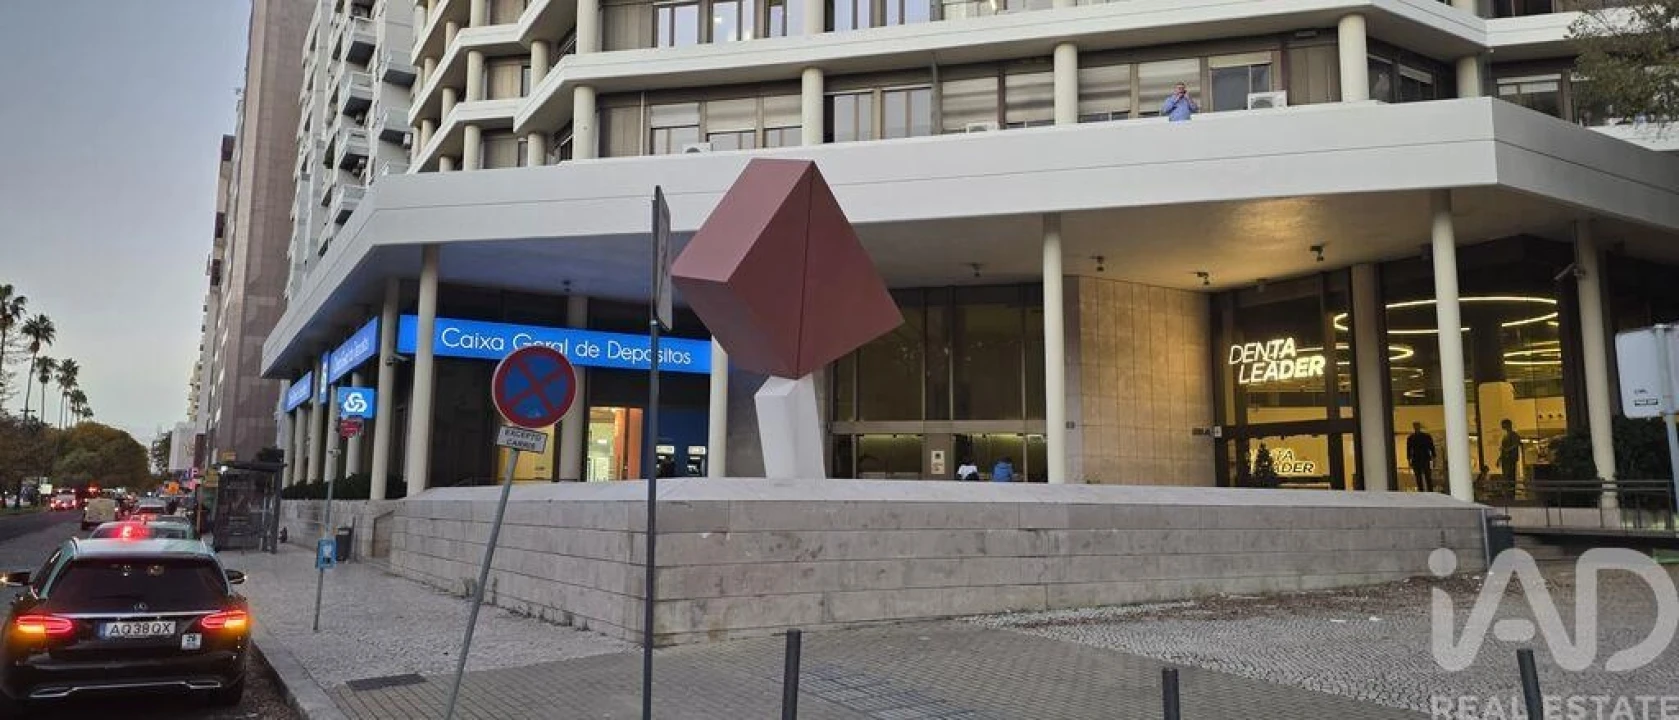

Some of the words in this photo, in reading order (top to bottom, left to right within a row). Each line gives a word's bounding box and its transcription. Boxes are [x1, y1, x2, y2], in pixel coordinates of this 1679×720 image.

[442, 327, 504, 351] Caixa
[575, 341, 600, 358] de
[1228, 337, 1297, 364] DENTA
[1239, 355, 1326, 384] LEADER
